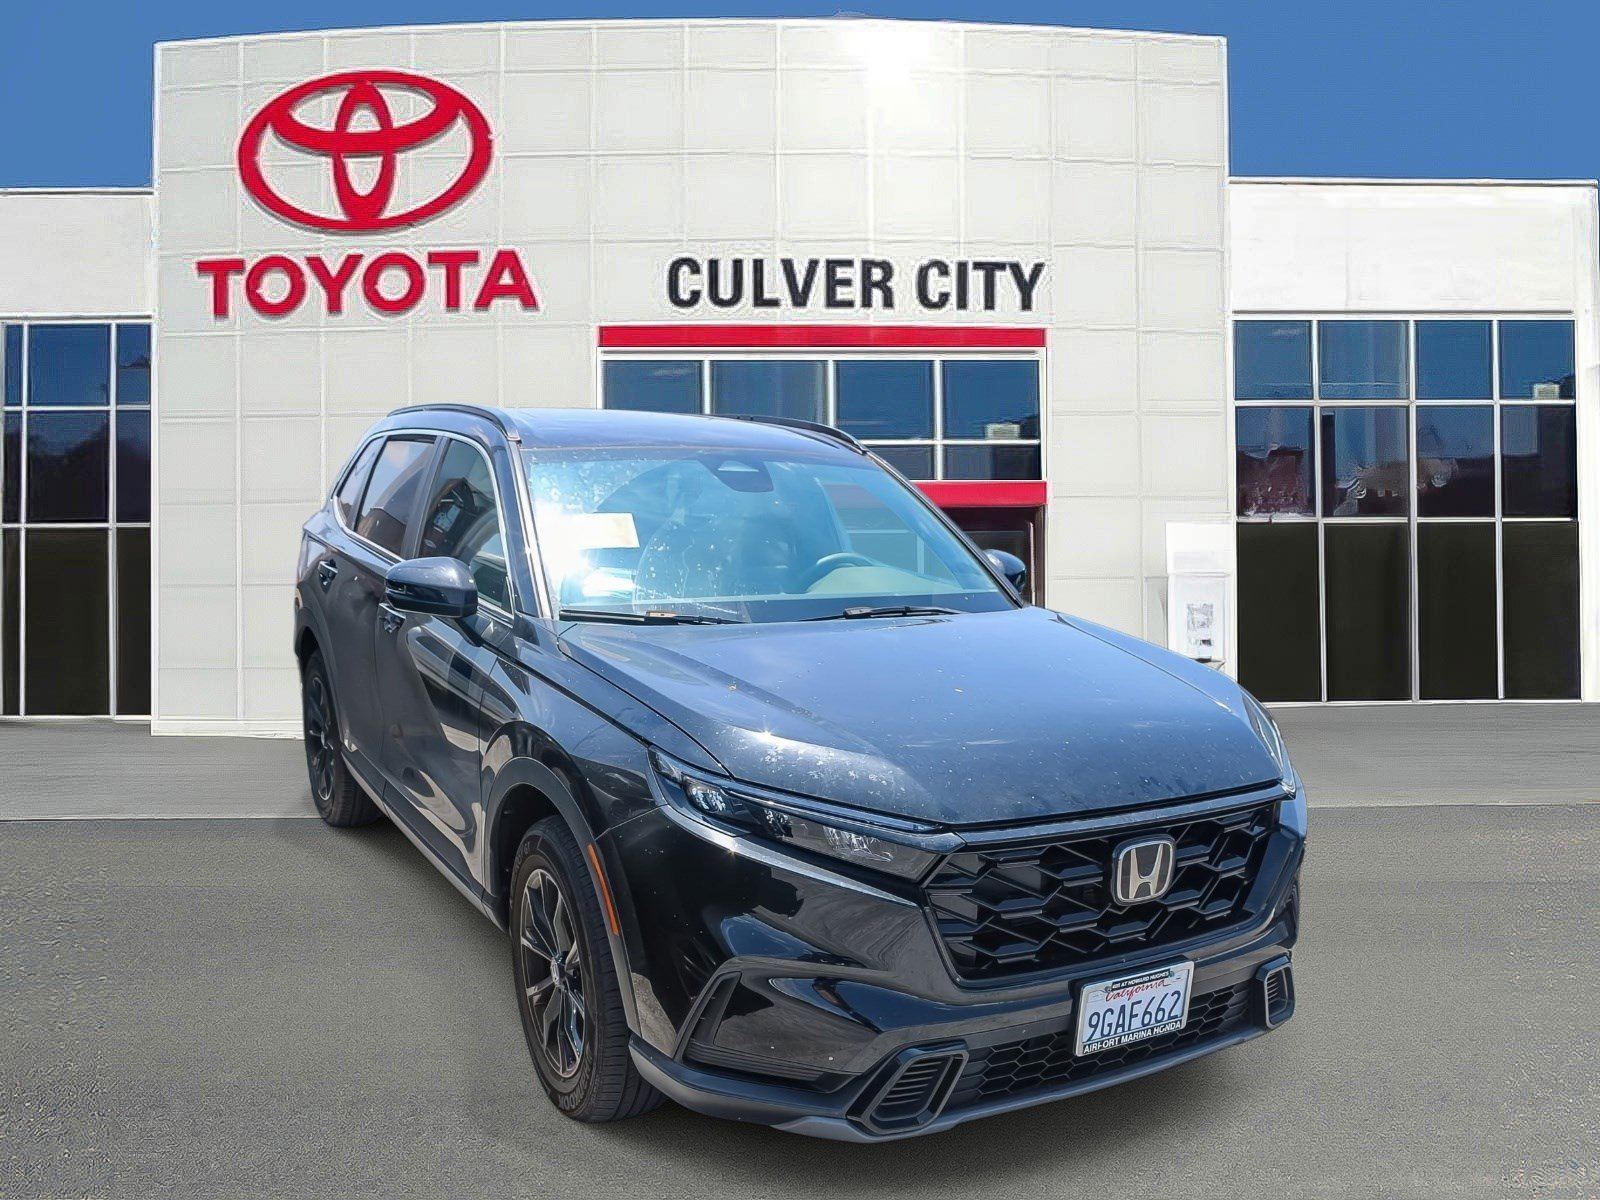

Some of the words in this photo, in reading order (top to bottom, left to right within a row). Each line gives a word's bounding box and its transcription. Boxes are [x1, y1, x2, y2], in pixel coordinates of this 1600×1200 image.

[195, 249, 538, 317] TOYOTA
[668, 257, 894, 310] CULVER
[916, 258, 1046, 311] CITY
[1105, 979, 1171, 1002] California
[1128, 975, 1150, 986] HOWARD
[1149, 971, 1169, 980] HUGHES
[1085, 990, 1180, 1041] 9GAF662
[1121, 1029, 1152, 1043] MARINA
[1153, 1021, 1180, 1034] HONDA
